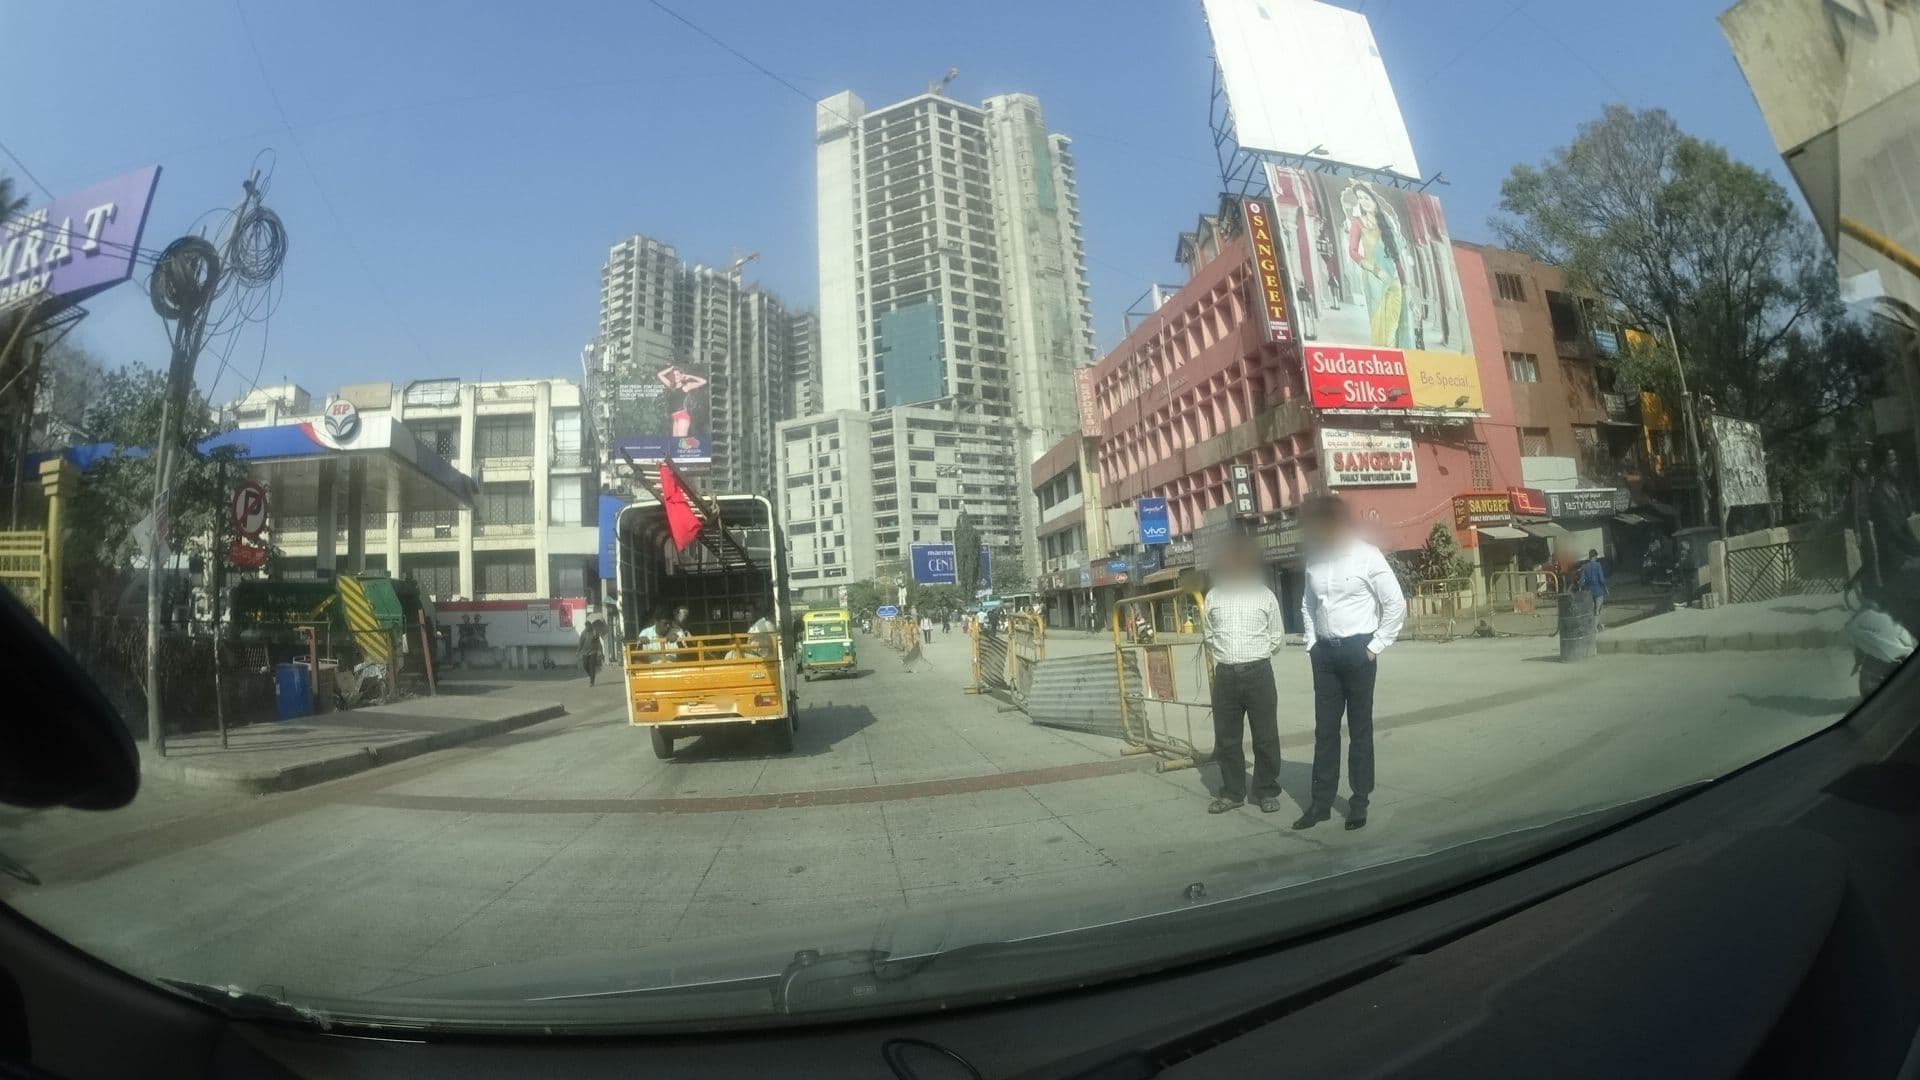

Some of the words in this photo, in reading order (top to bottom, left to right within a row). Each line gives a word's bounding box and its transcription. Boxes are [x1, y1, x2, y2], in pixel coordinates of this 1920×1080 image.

[1252, 215, 1282, 318] SANGEET
[1313, 351, 1405, 376] Sudarshan
[1420, 371, 1434, 385] Be
[1343, 380, 1387, 402] Silks
[332, 404, 350, 416] HP
[1333, 451, 1413, 472] SANGEET
[1234, 467, 1252, 511] BAR
[1469, 499, 1510, 513] SANGEET
[1143, 527, 1167, 535] vivo
